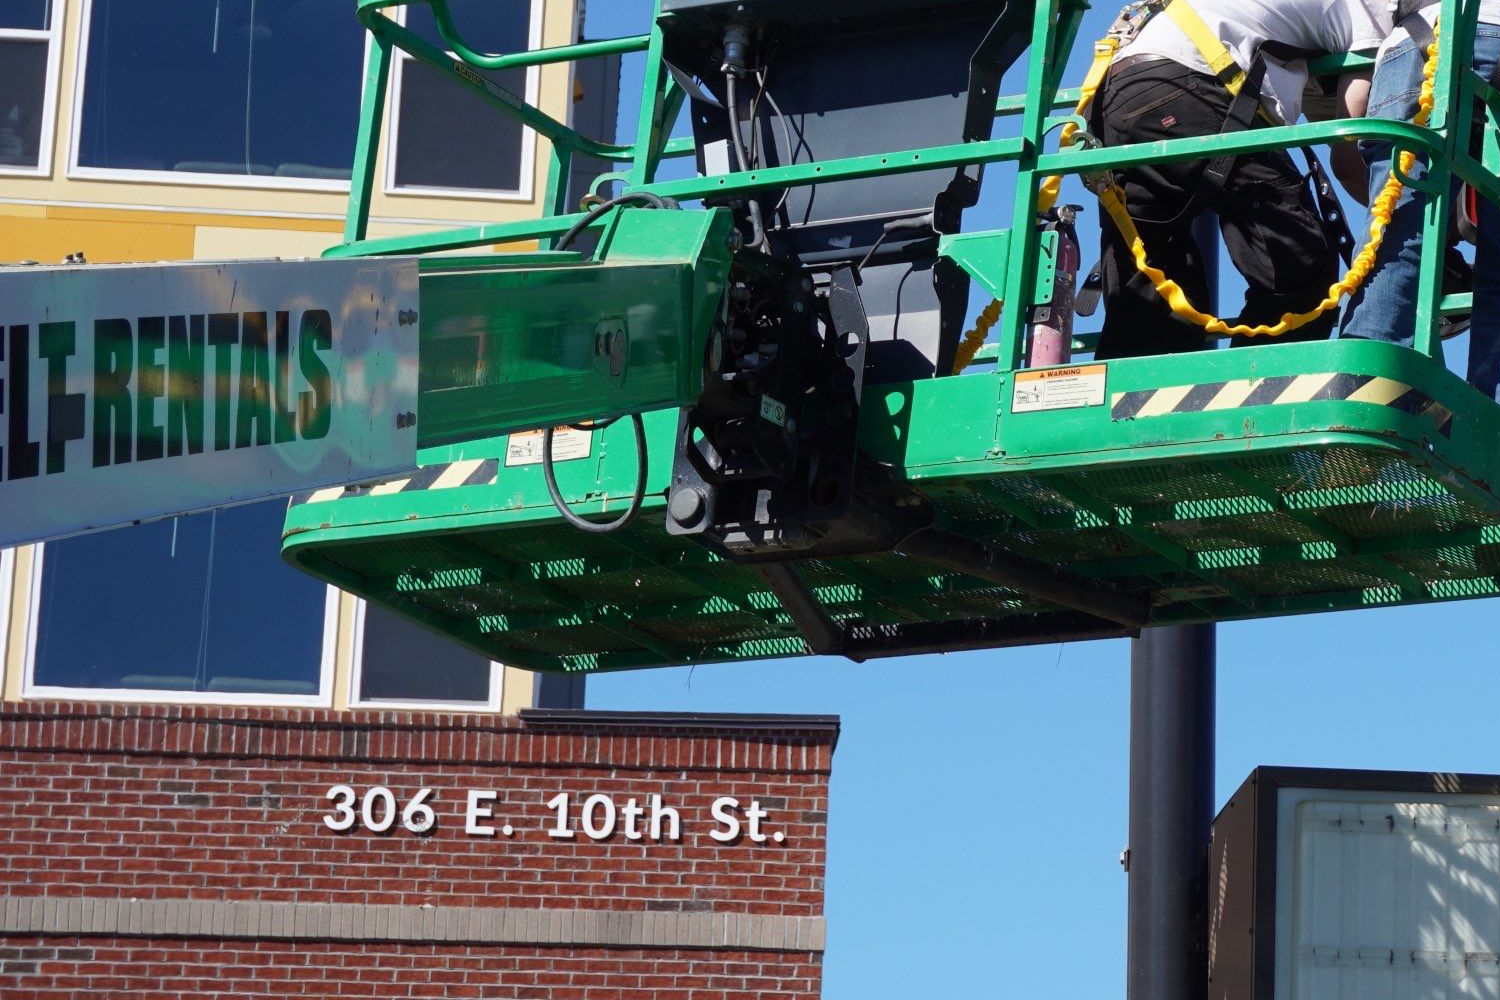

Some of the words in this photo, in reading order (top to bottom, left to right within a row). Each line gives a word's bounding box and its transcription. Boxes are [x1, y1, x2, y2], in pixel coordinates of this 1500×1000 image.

[0, 320, 76, 482] LT
[93, 309, 332, 468] RENTALS
[1047, 368, 1081, 378] WARNING
[322, 785, 435, 833] 306
[464, 789, 513, 836] E.
[547, 792, 680, 841] 10th
[708, 796, 786, 842] St.
